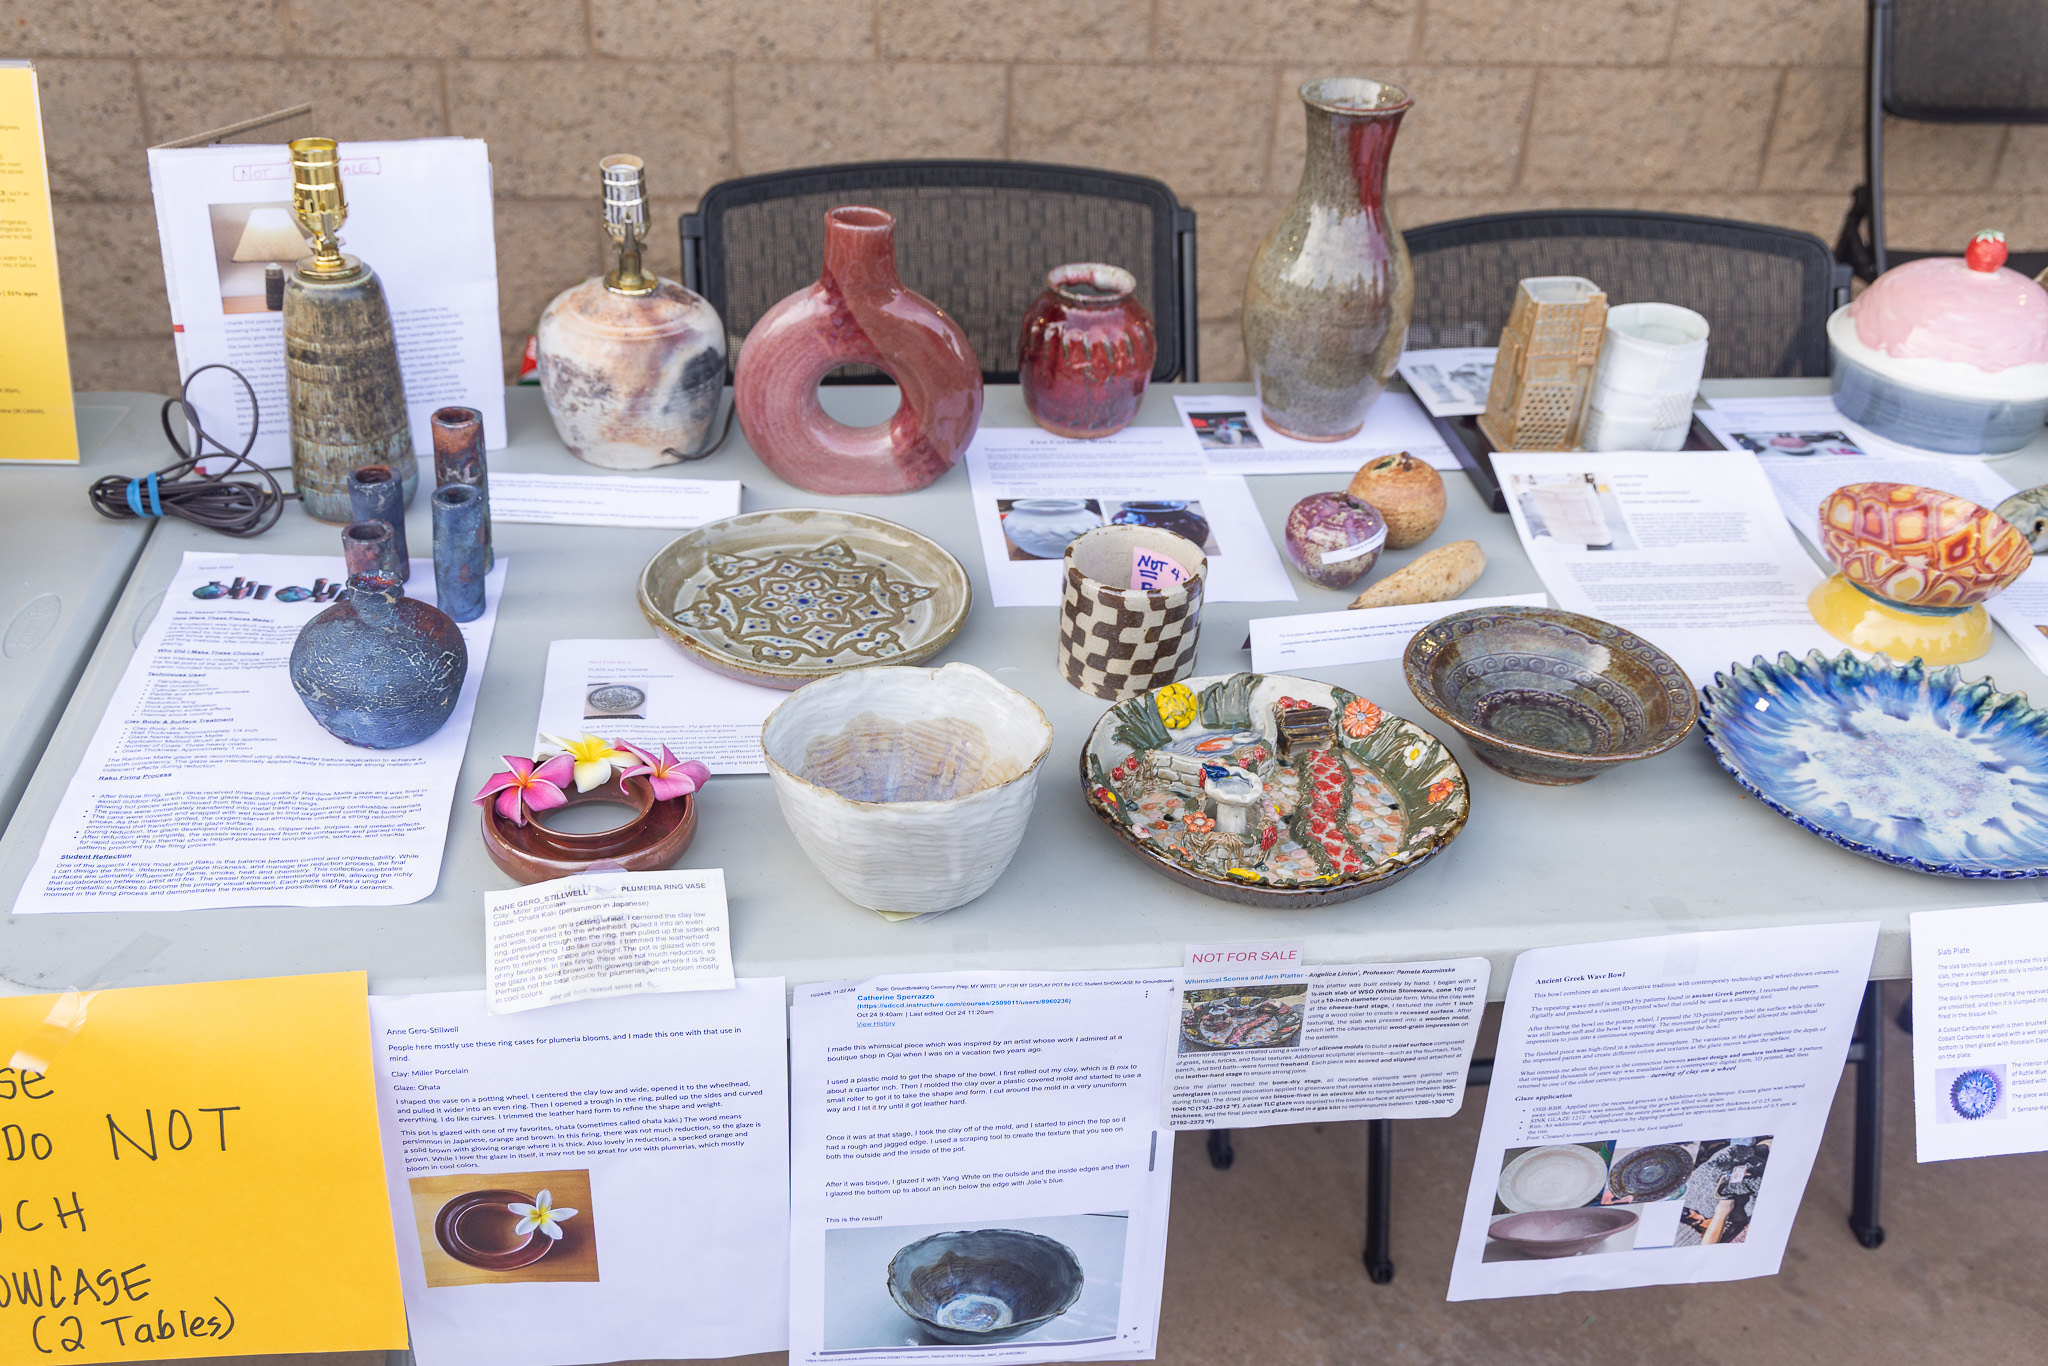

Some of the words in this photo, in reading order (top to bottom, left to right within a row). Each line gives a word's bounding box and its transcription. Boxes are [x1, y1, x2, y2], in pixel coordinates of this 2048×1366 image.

[344, 163, 373, 175] ALE
[1138, 555, 1168, 572] NOT
[492, 902, 515, 912] ANNE
[1192, 953, 1224, 963] NOT
[1227, 952, 1257, 962] FOR
[1260, 950, 1297, 960] SALE
[2, 1124, 52, 1160] Do
[106, 1106, 240, 1161] NOT
[0, 1191, 86, 1232] CH
[33, 1315, 85, 1353] (2
[101, 1296, 235, 1346] Tables)
